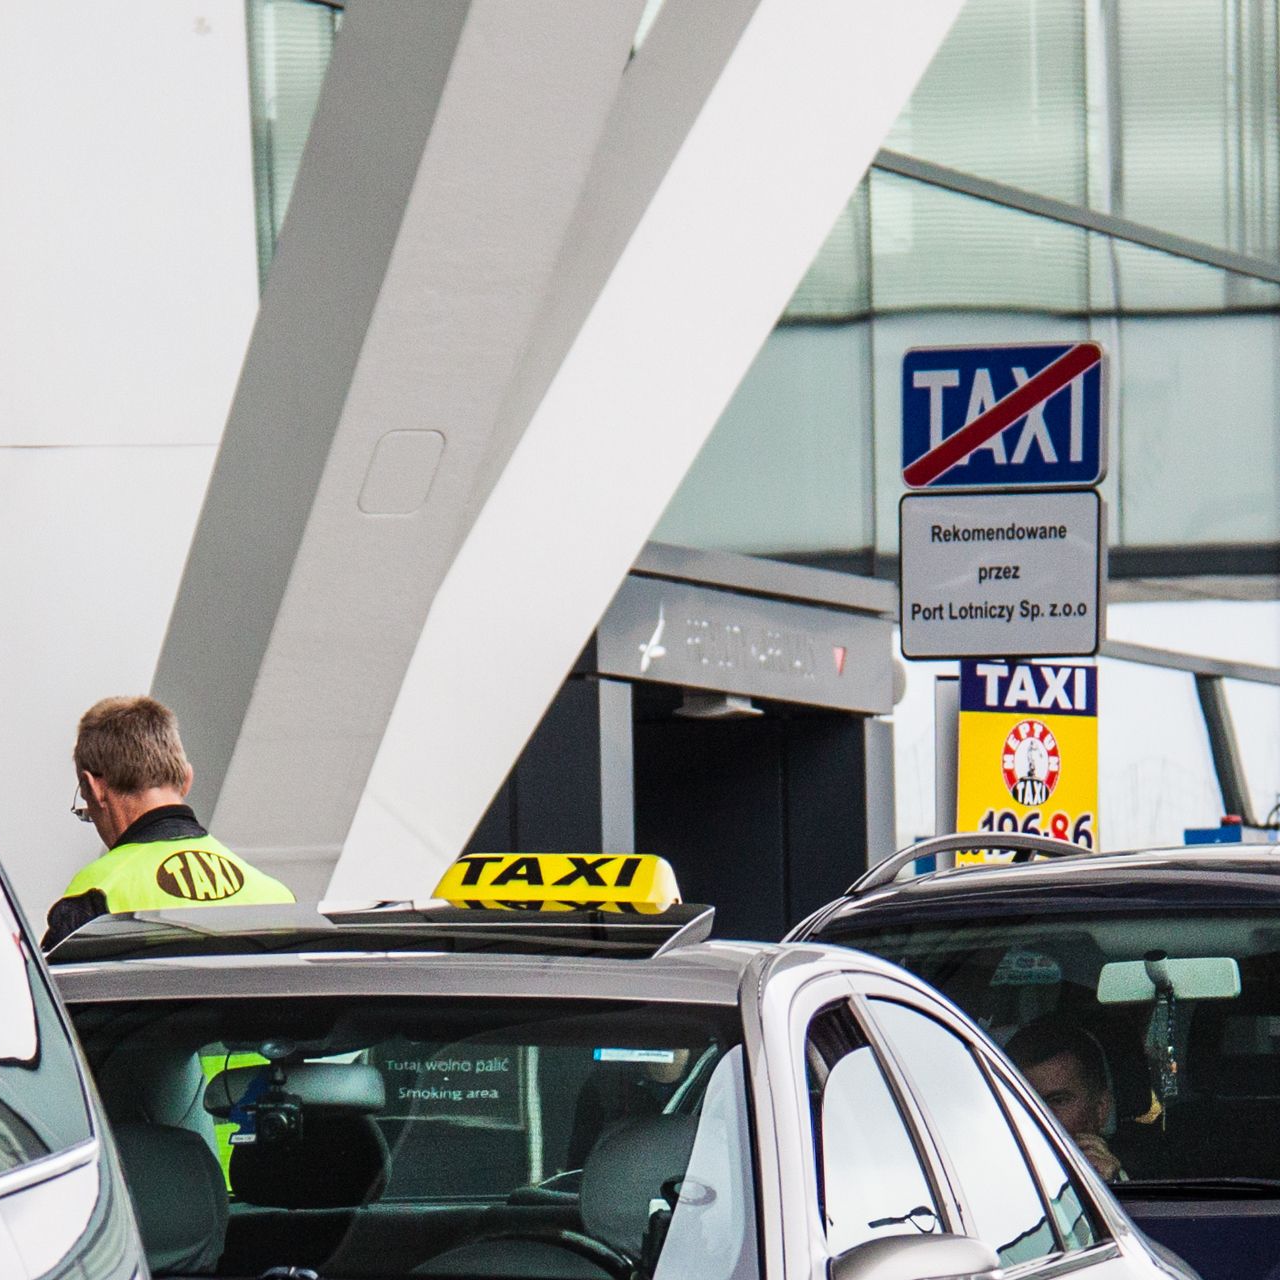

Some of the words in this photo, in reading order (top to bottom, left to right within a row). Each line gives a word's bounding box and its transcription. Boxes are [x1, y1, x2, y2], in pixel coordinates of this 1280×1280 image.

[913, 367, 1083, 466] TAXI
[931, 523, 1067, 543] Rekomendowane
[978, 565, 1020, 584] przez
[911, 602, 944, 621] Port
[948, 601, 1015, 623] Lotniczy
[1020, 600, 1044, 622] Sp.
[1049, 602, 1087, 617] z.o.o
[976, 663, 1087, 710] TAXI
[1017, 780, 1047, 806] TAXI
[163, 851, 241, 900] TAXI
[456, 857, 642, 887] TAXI
[425, 1057, 471, 1072] wolno
[398, 1087, 462, 1101] Smoking
[466, 1088, 499, 1099] area
